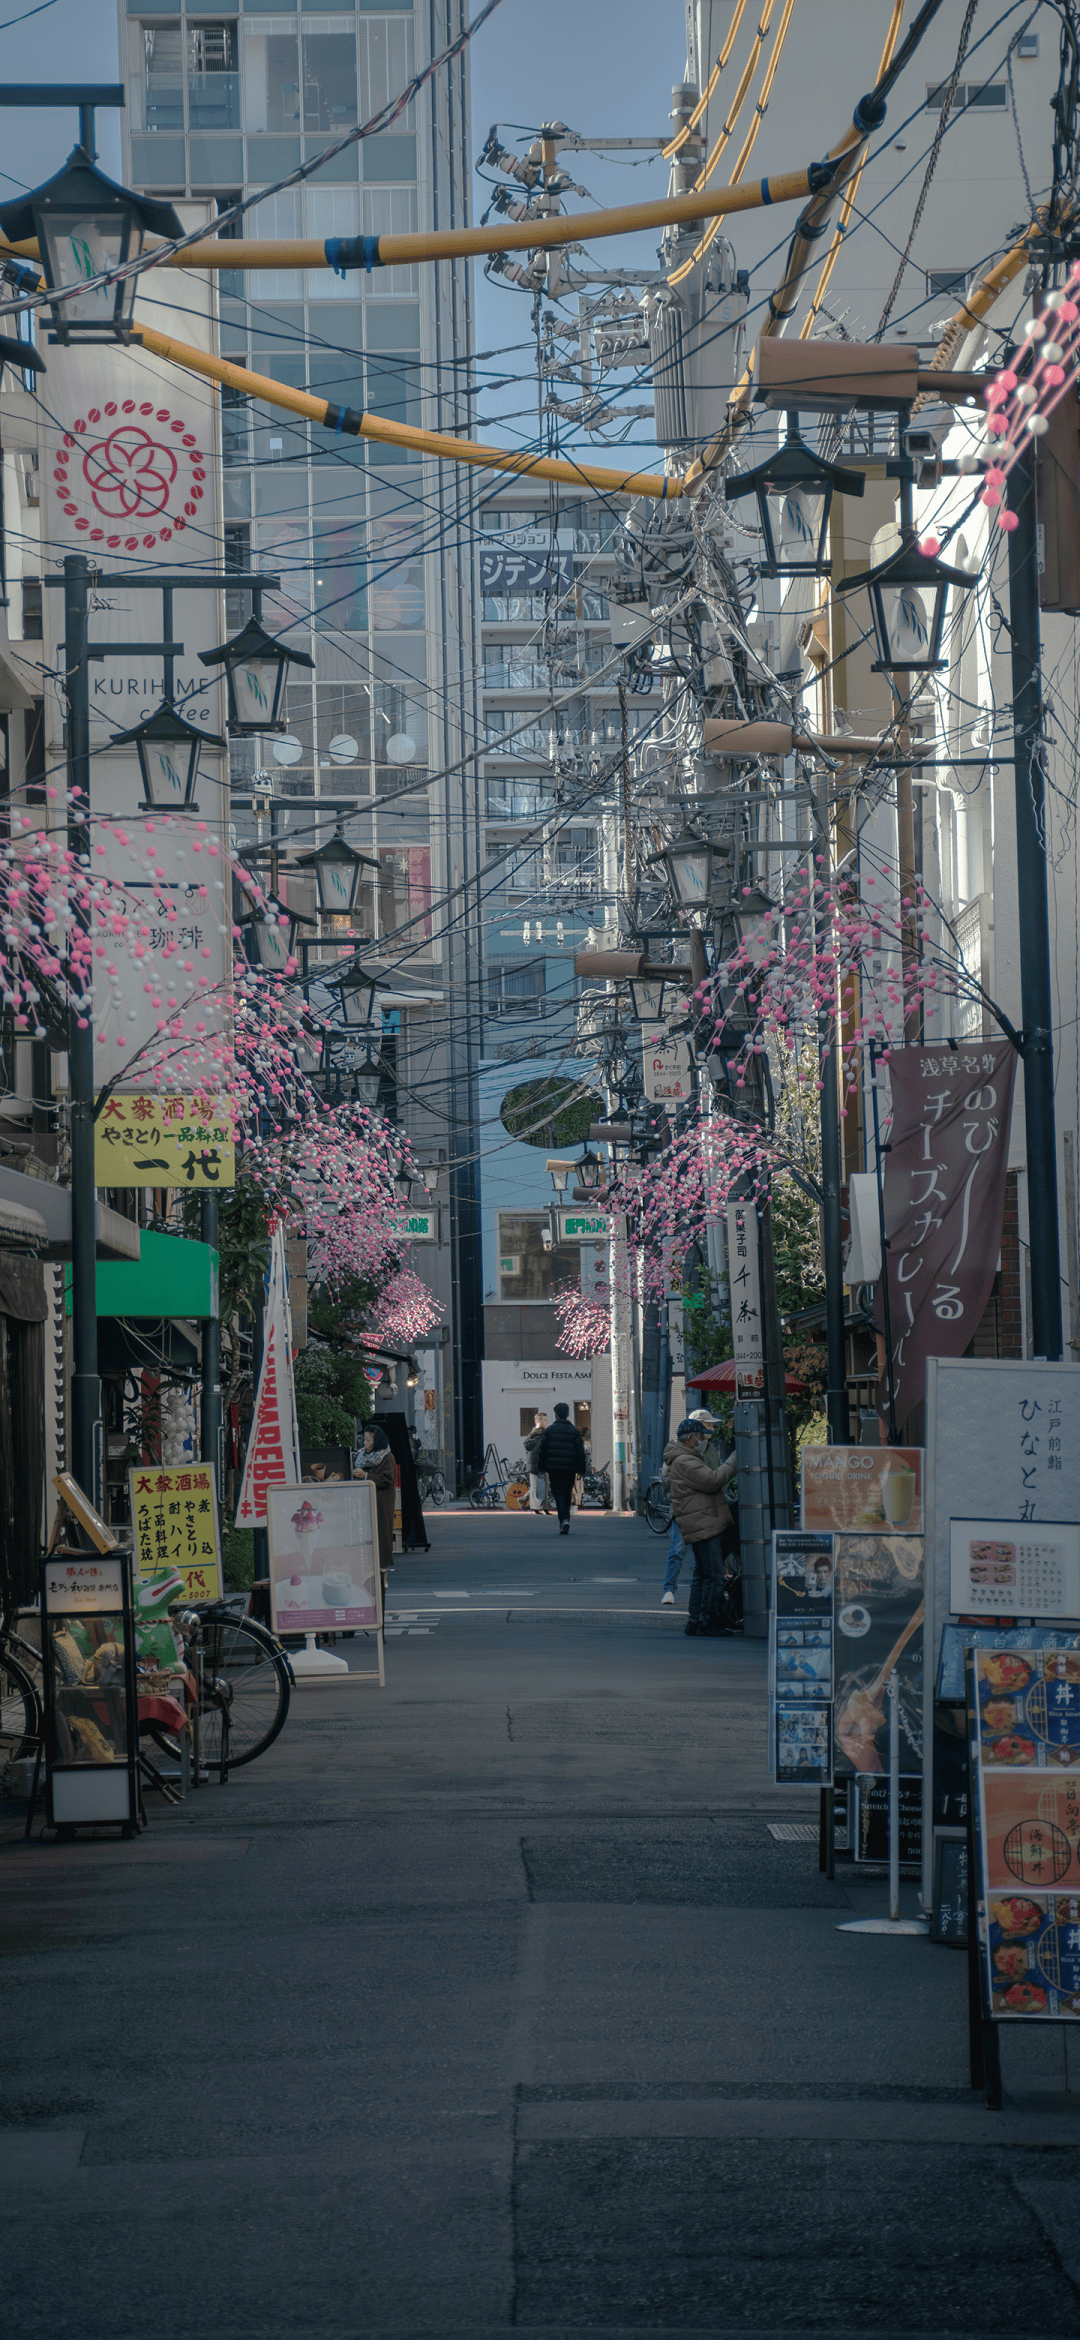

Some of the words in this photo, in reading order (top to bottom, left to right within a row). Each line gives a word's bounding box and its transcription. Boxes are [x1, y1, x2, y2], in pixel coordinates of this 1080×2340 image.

[95, 678, 209, 695] KURIHME
[140, 703, 211, 721] cfee
[149, 926, 204, 949] 珈琲
[920, 1055, 997, 1078] 浅草名物
[101, 1096, 214, 1122] 大衆酒場
[133, 1149, 222, 1181] 一代
[1047, 1399, 1063, 1471] 江戸前鮨
[810, 1455, 875, 1470] MANGO
[1018, 1398, 1043, 1521] ひなと丸
[135, 1472, 211, 1495] 大衆酒場
[811, 1472, 845, 1481] YOGURT
[847, 1472, 874, 1481] DRINK
[138, 1504, 154, 1562] ろばた焼
[154, 1503, 171, 1559] 一品料理
[169, 1501, 183, 1557] 酎ハイ
[185, 1500, 199, 1557] やきとり
[185, 1571, 206, 1589] 代
[839, 1580, 873, 1594] PAN
[1055, 1683, 1075, 1706] 丼
[1029, 1829, 1046, 1874] 海鮮丼
